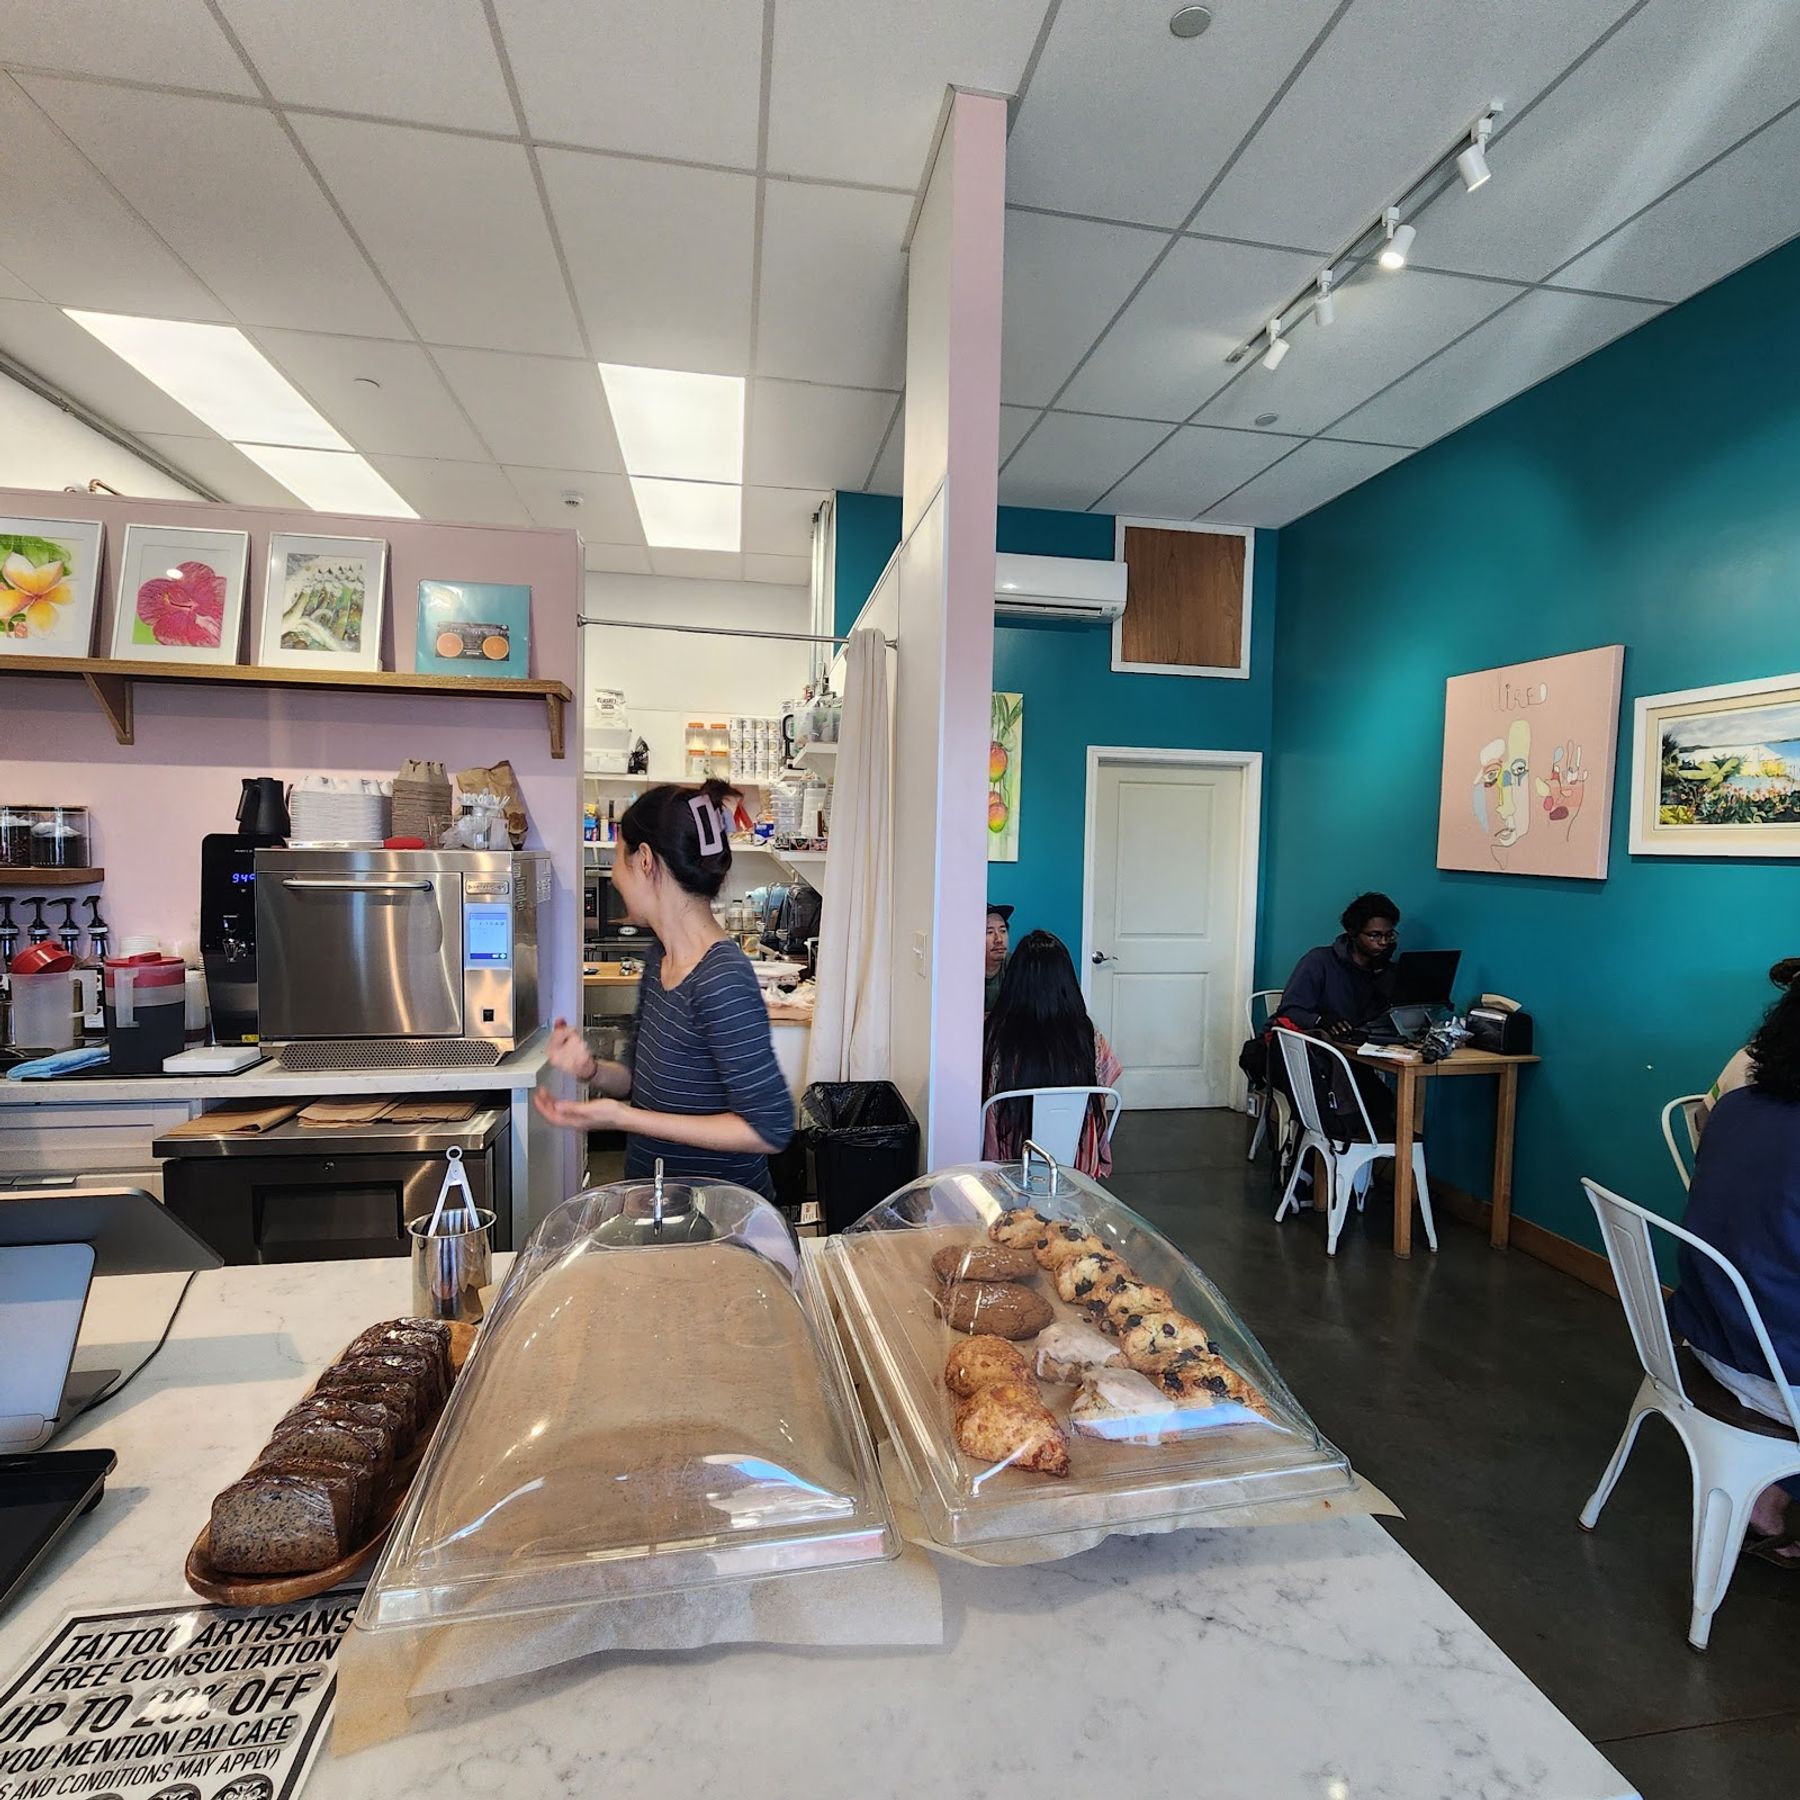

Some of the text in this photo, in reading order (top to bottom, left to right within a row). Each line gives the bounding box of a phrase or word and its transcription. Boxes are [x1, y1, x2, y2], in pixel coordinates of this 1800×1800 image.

[186, 1605, 359, 1650] ARTISANS
[31, 1637, 343, 1693] FREE CONSULTATION
[0, 1702, 67, 1744] UP
[67, 1695, 133, 1737] TO
[227, 1671, 321, 1716] OFF
[0, 1714, 299, 1774] YOU MENTION PAI CAFE
[10, 1777, 57, 1800] AND
[56, 1762, 177, 1795] CONDITIONS
[173, 1755, 216, 1780] MAY
[216, 1748, 280, 1774] APPLY)
